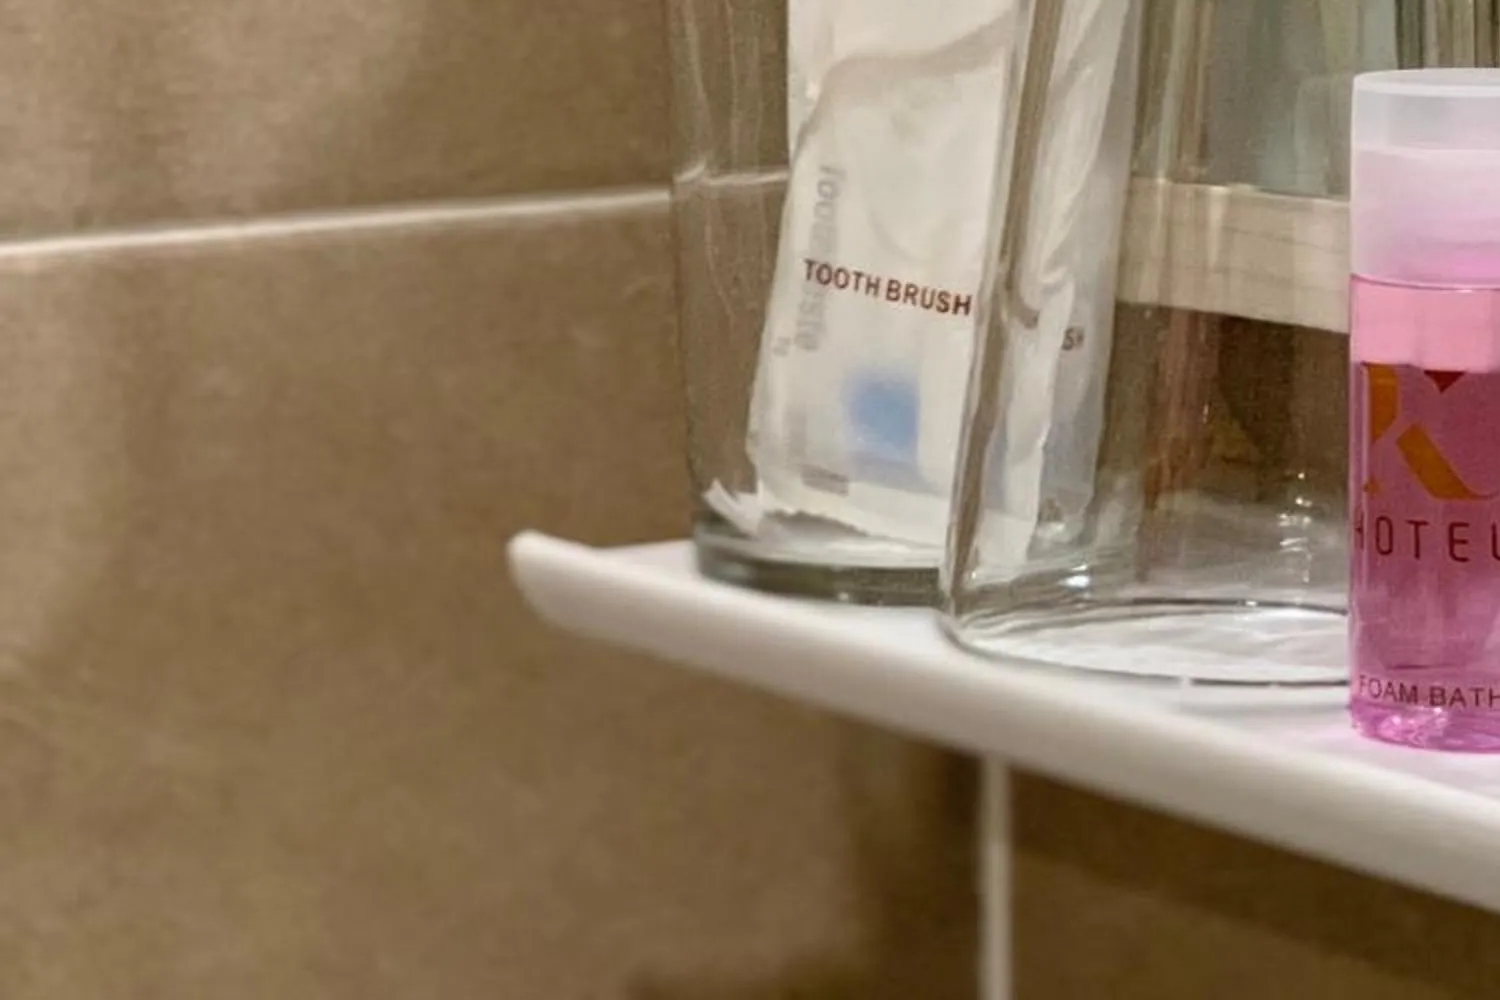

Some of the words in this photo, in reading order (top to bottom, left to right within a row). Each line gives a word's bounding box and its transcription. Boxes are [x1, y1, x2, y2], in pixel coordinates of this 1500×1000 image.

[804, 259, 881, 297] TOOTH
[886, 279, 973, 317] BRUSH
[1359, 675, 1418, 704] FOAM
